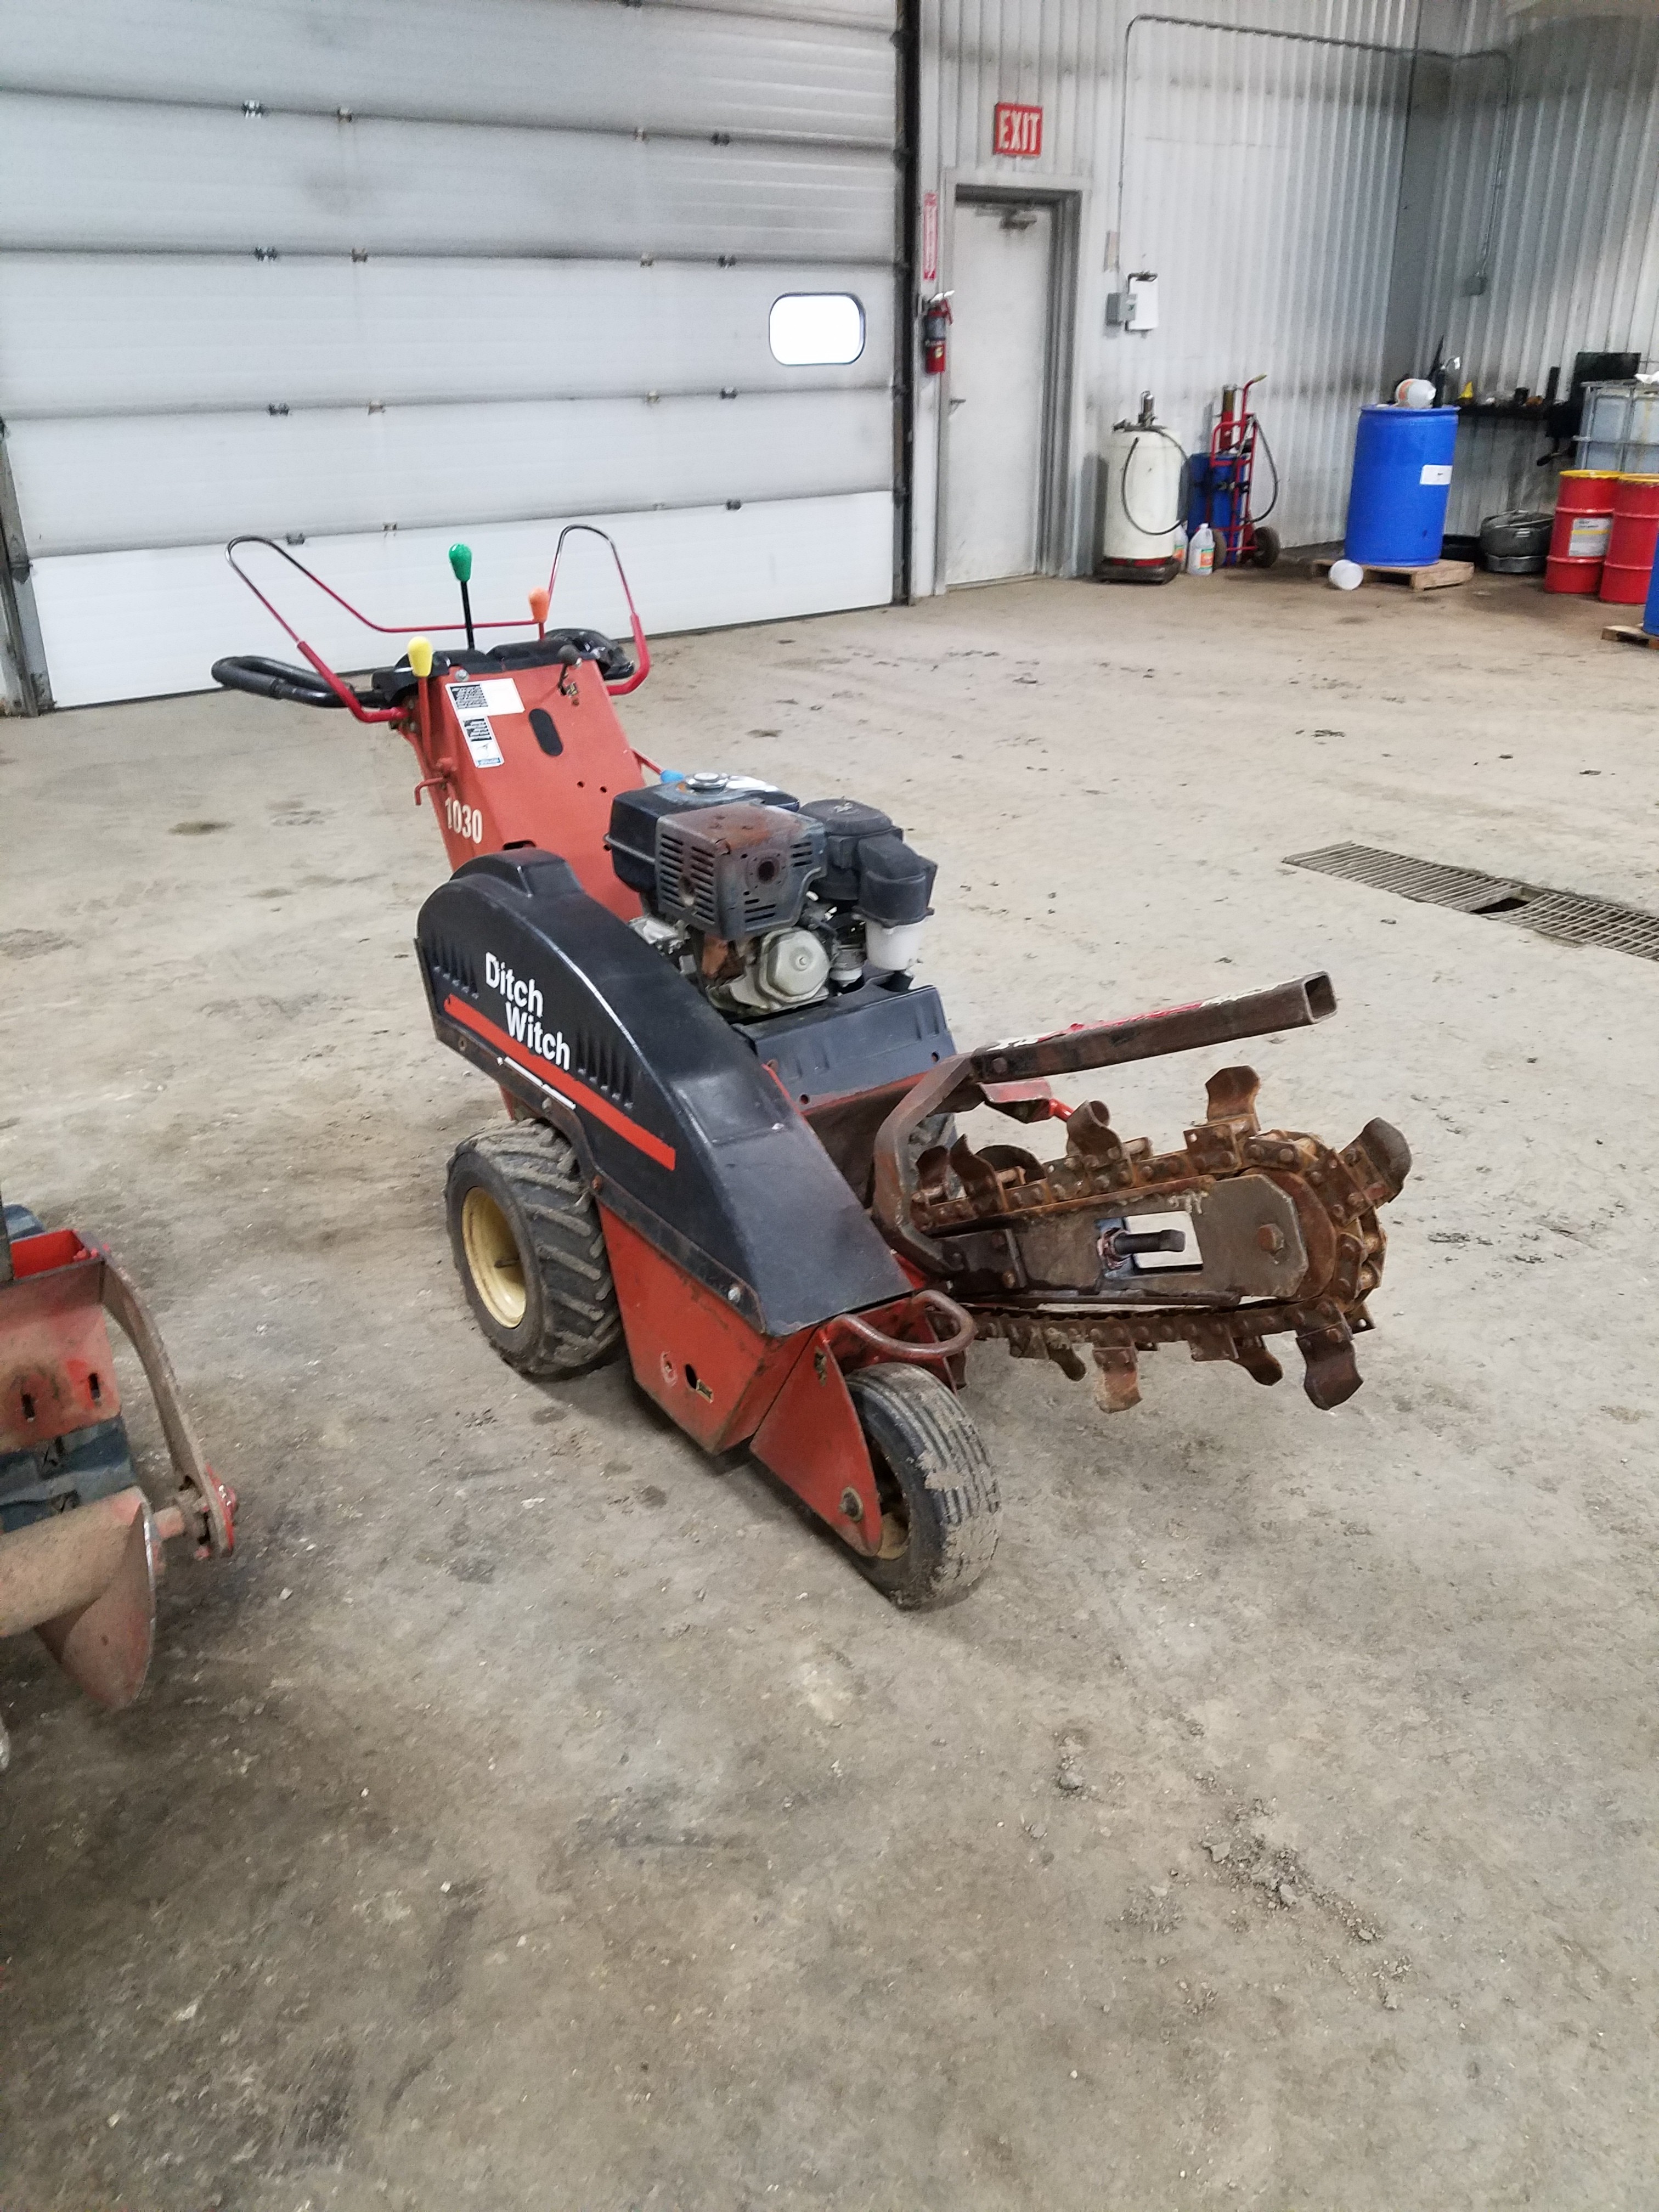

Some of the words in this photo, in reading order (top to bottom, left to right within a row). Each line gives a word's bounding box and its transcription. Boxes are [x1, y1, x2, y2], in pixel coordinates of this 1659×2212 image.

[1000, 110, 1040, 151] EXIT
[445, 797, 483, 844] 1030
[486, 952, 543, 1018] Ditch
[505, 1001, 570, 1071] Witch
